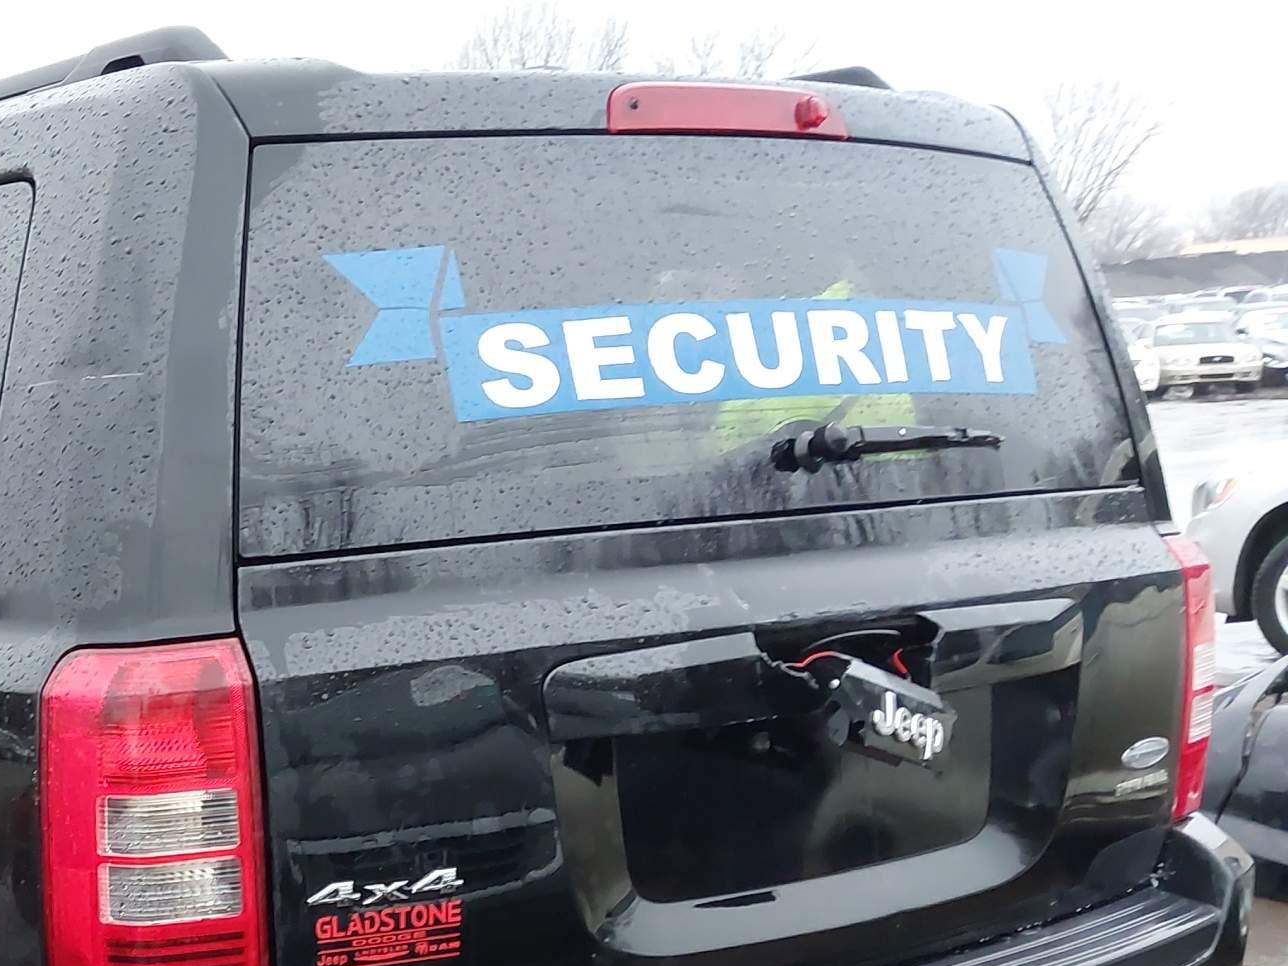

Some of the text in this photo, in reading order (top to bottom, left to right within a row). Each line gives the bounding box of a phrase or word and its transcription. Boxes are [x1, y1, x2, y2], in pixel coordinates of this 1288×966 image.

[478, 308, 1009, 408] SECURITY
[873, 690, 944, 760] Jeep
[314, 899, 462, 940] GLADSTONE
[351, 930, 427, 947] DODGE
